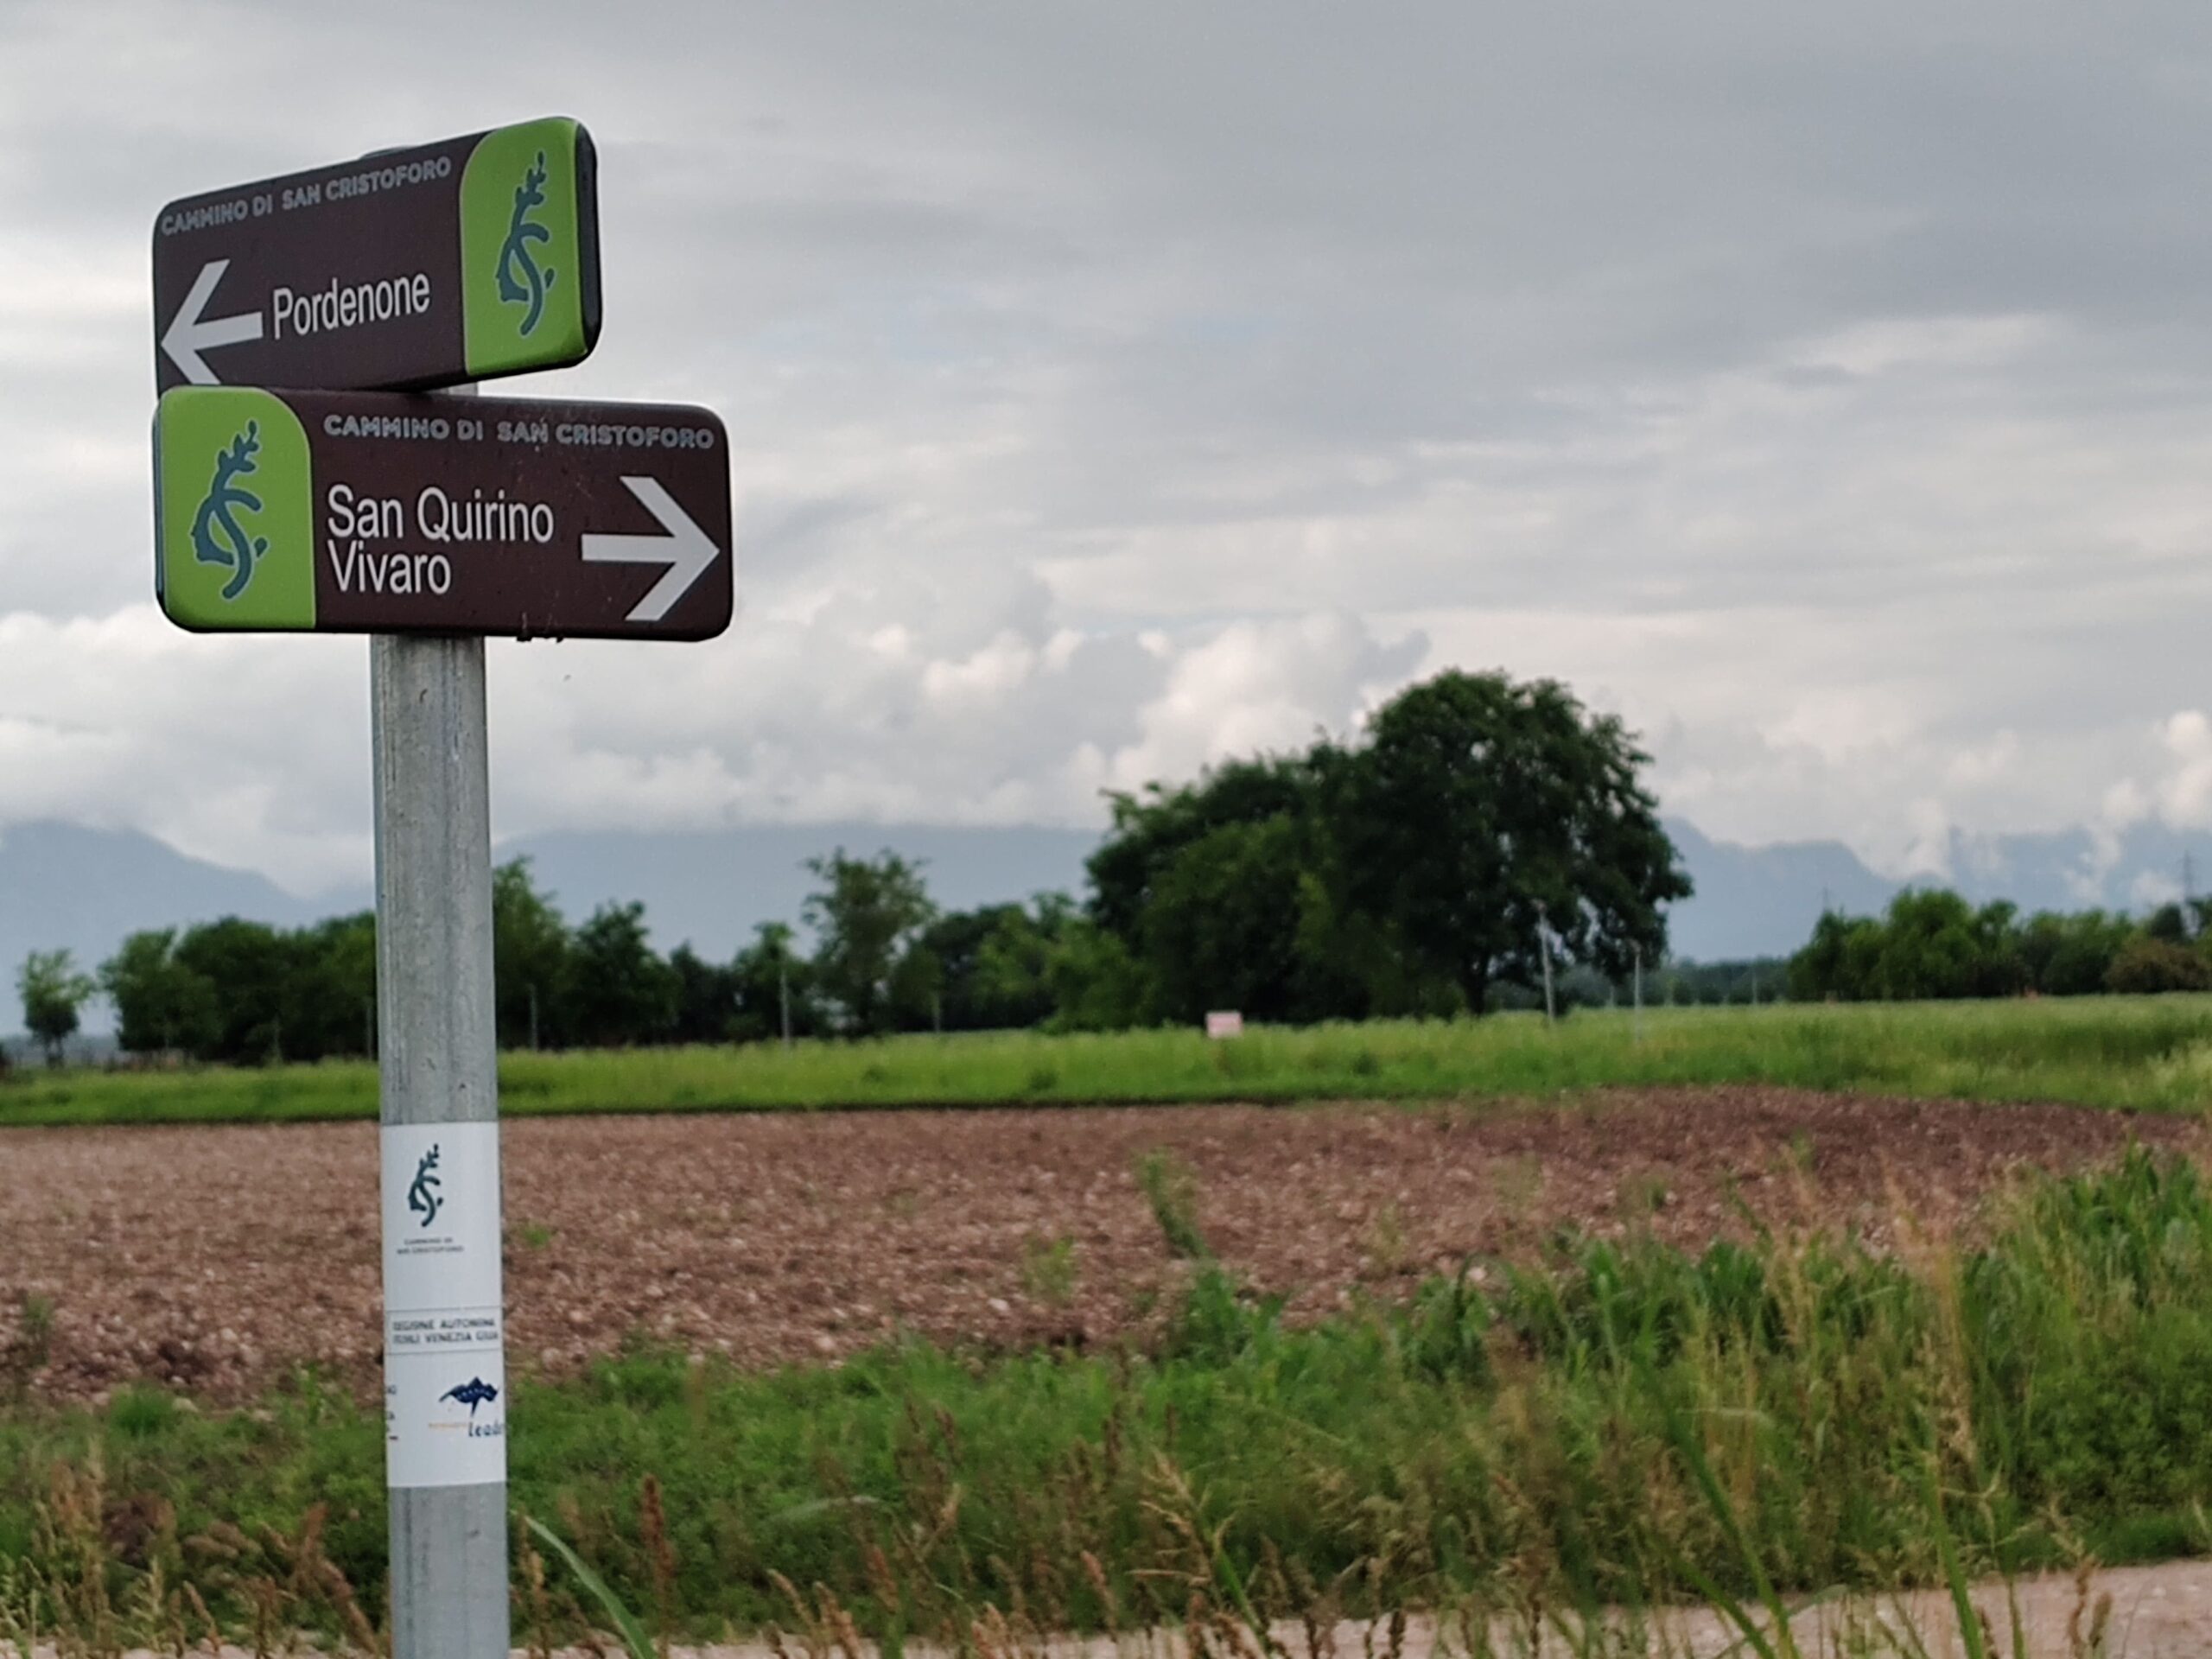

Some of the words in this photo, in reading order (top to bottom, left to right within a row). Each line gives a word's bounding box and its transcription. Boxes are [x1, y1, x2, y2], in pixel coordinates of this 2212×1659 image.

[162, 200, 247, 235] CAMMINO
[252, 195, 273, 218] DI
[282, 184, 321, 210] SAN
[326, 156, 451, 199] CRISTOFORO
[272, 272, 430, 340] Pordenone
[324, 415, 449, 440] CAMMINO
[457, 419, 483, 442] DI
[497, 420, 548, 443] SAN
[556, 423, 715, 449] CRISTOFORO
[327, 484, 404, 539] San
[416, 486, 555, 543] Quirino
[327, 540, 452, 594] Vivaro
